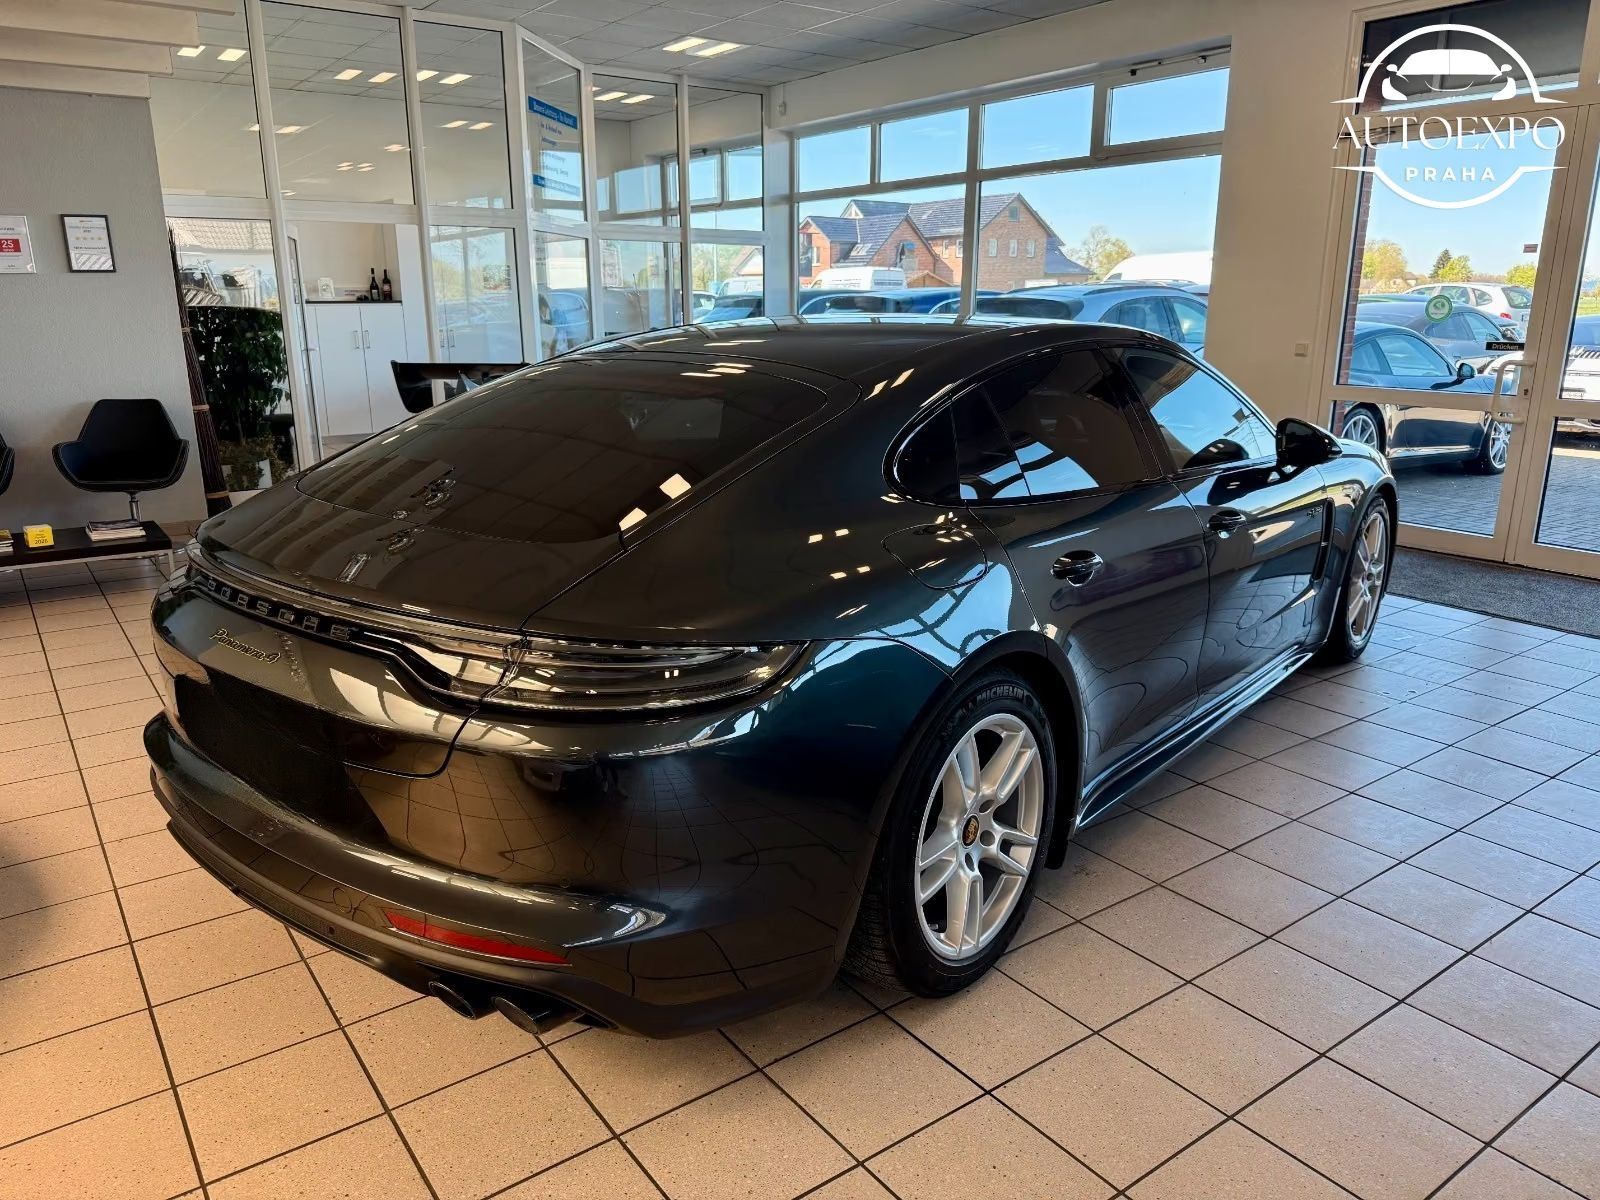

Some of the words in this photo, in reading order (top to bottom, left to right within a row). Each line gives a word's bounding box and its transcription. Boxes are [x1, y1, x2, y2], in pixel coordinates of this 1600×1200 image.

[1, 240, 14, 248] 25
[1491, 343, 1519, 351] Drücken
[976, 685, 1027, 704] MICHELIN
